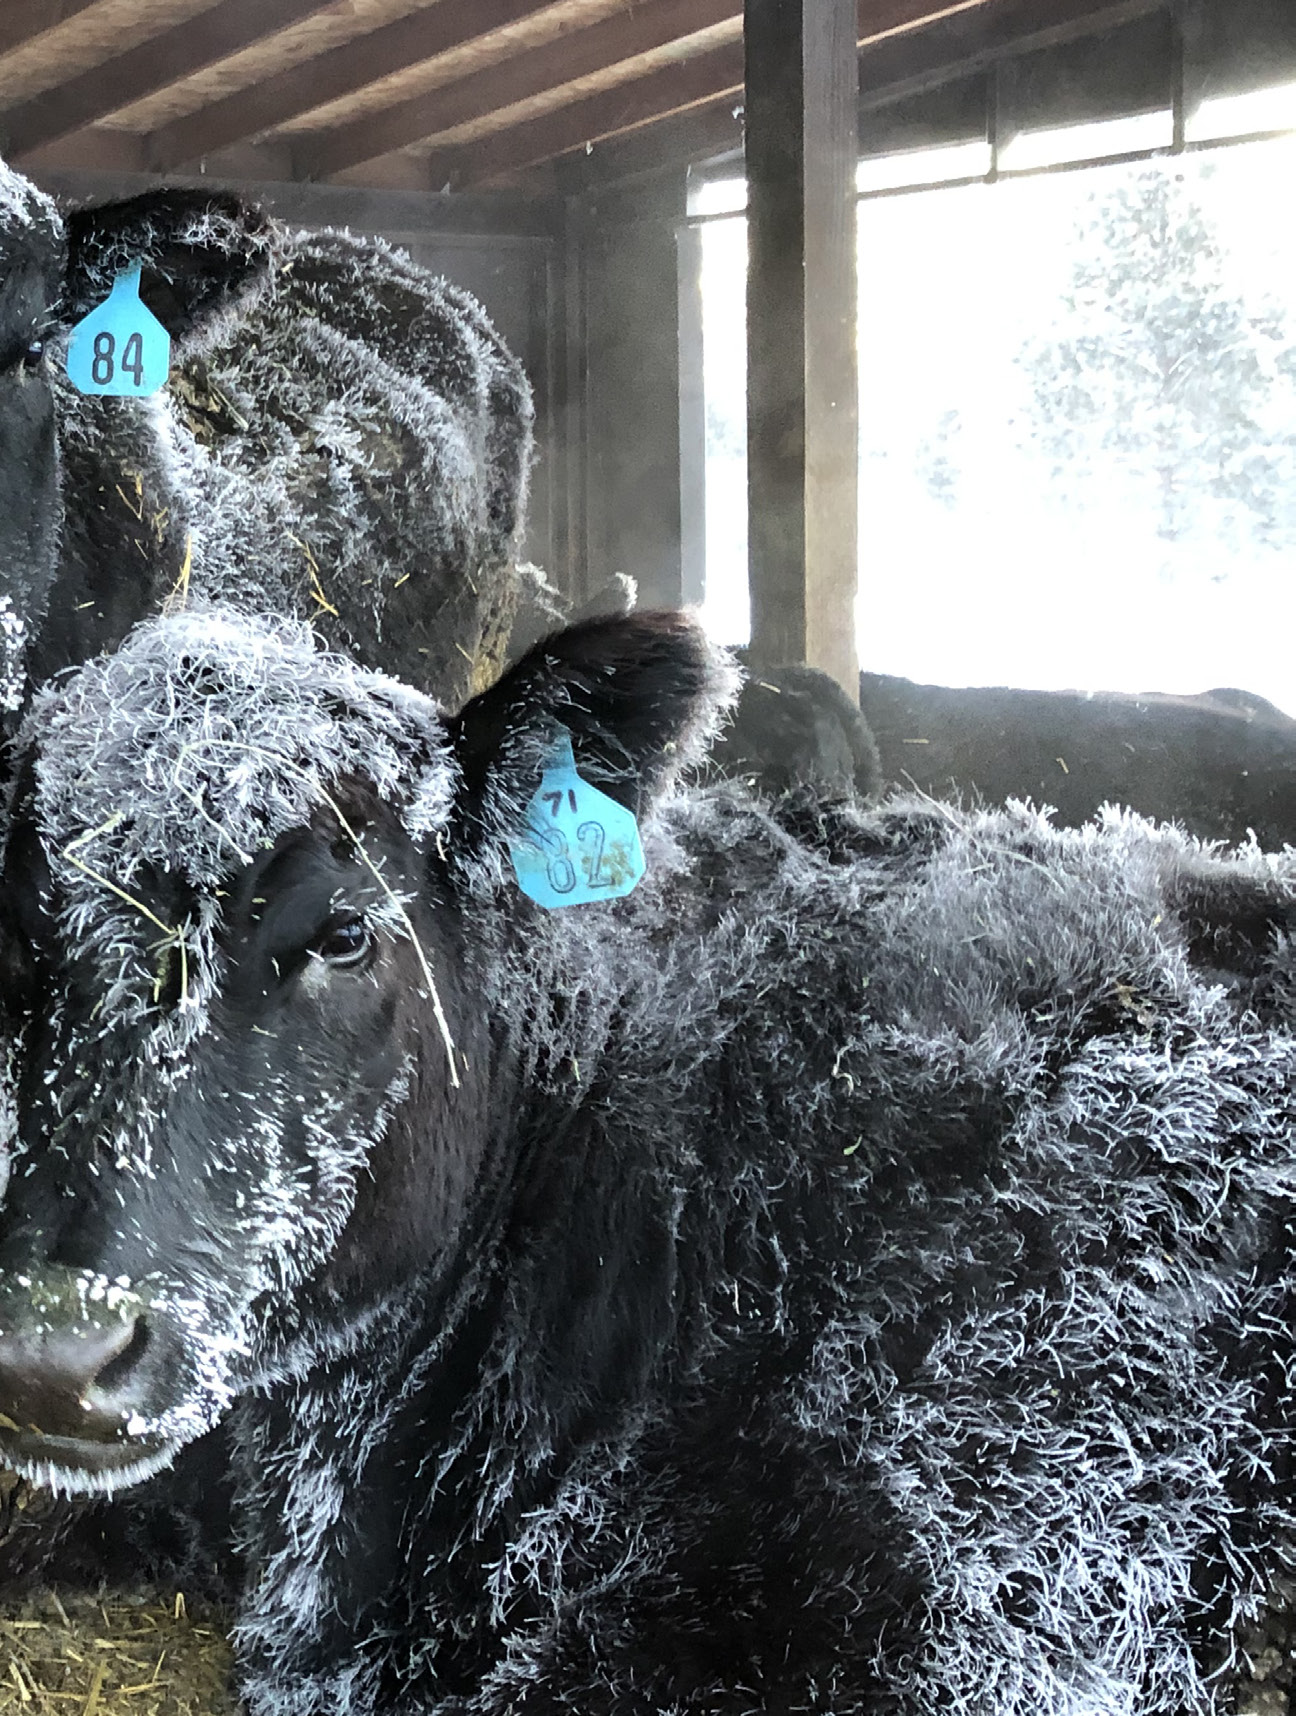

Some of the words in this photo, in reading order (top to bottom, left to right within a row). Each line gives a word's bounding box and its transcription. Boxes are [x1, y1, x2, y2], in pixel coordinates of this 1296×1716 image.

[91, 331, 144, 387] 84
[541, 788, 578, 818] 71
[540, 820, 616, 894] 82
